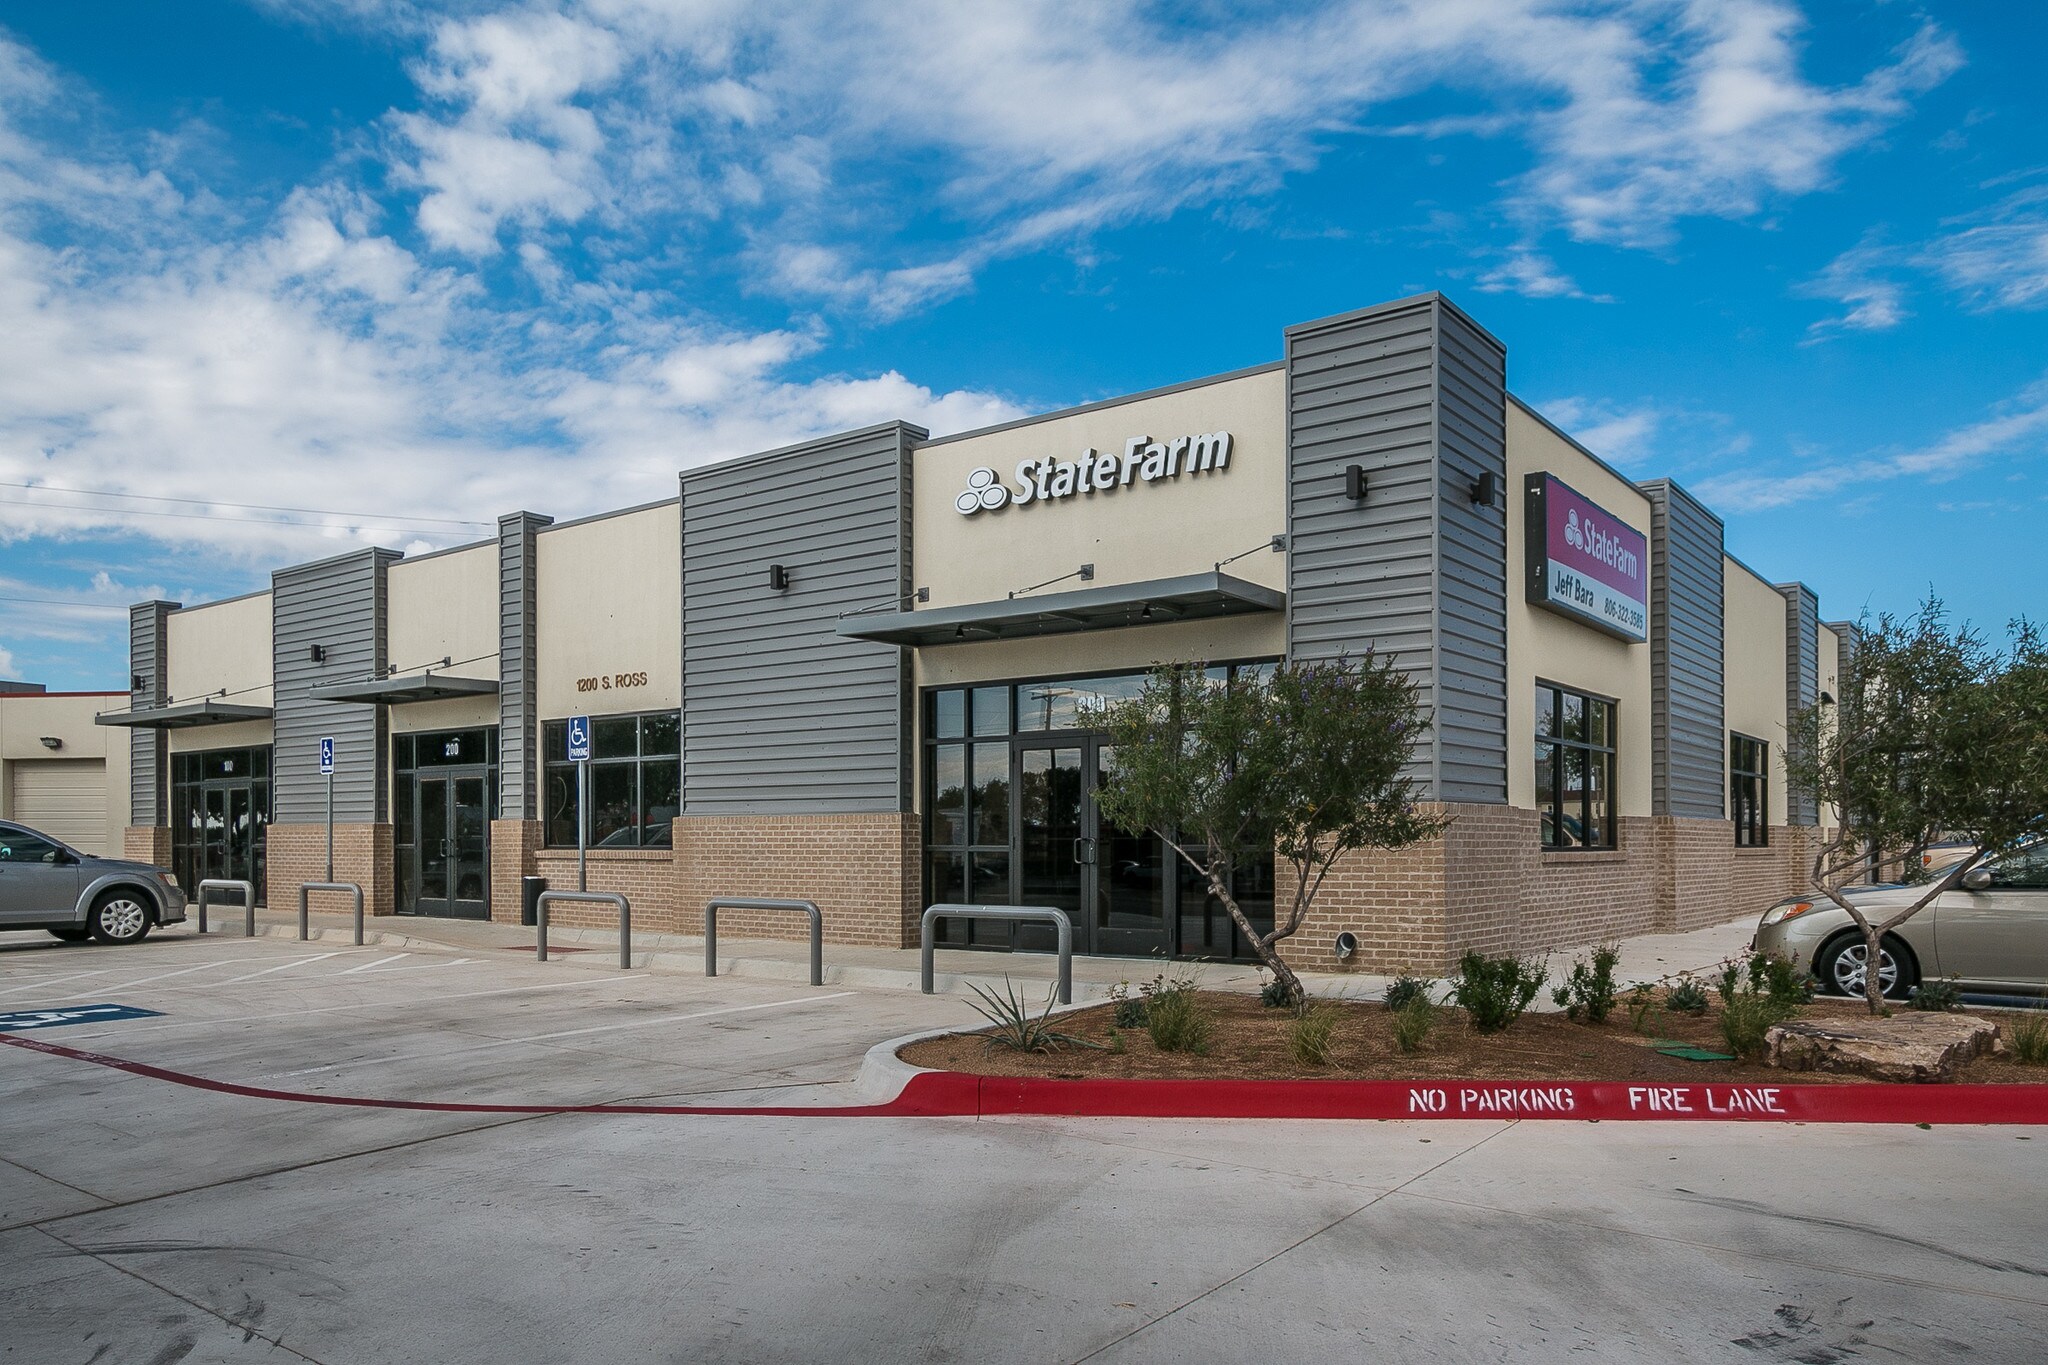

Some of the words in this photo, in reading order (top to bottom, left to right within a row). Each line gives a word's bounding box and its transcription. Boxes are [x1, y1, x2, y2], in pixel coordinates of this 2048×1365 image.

[1554, 570, 1574, 598] Jeff
[1574, 579, 1594, 608] Bara
[576, 677, 598, 692] 1200
[601, 675, 612, 690] S.
[615, 671, 648, 688] ROSS
[445, 742, 459, 756] 200
[570, 747, 588, 757] PARKING
[1409, 1088, 1446, 1112] NO
[1460, 1087, 1575, 1112] PARKING
[1628, 1086, 1693, 1112] FIRE
[1705, 1088, 1786, 1113] LANE
